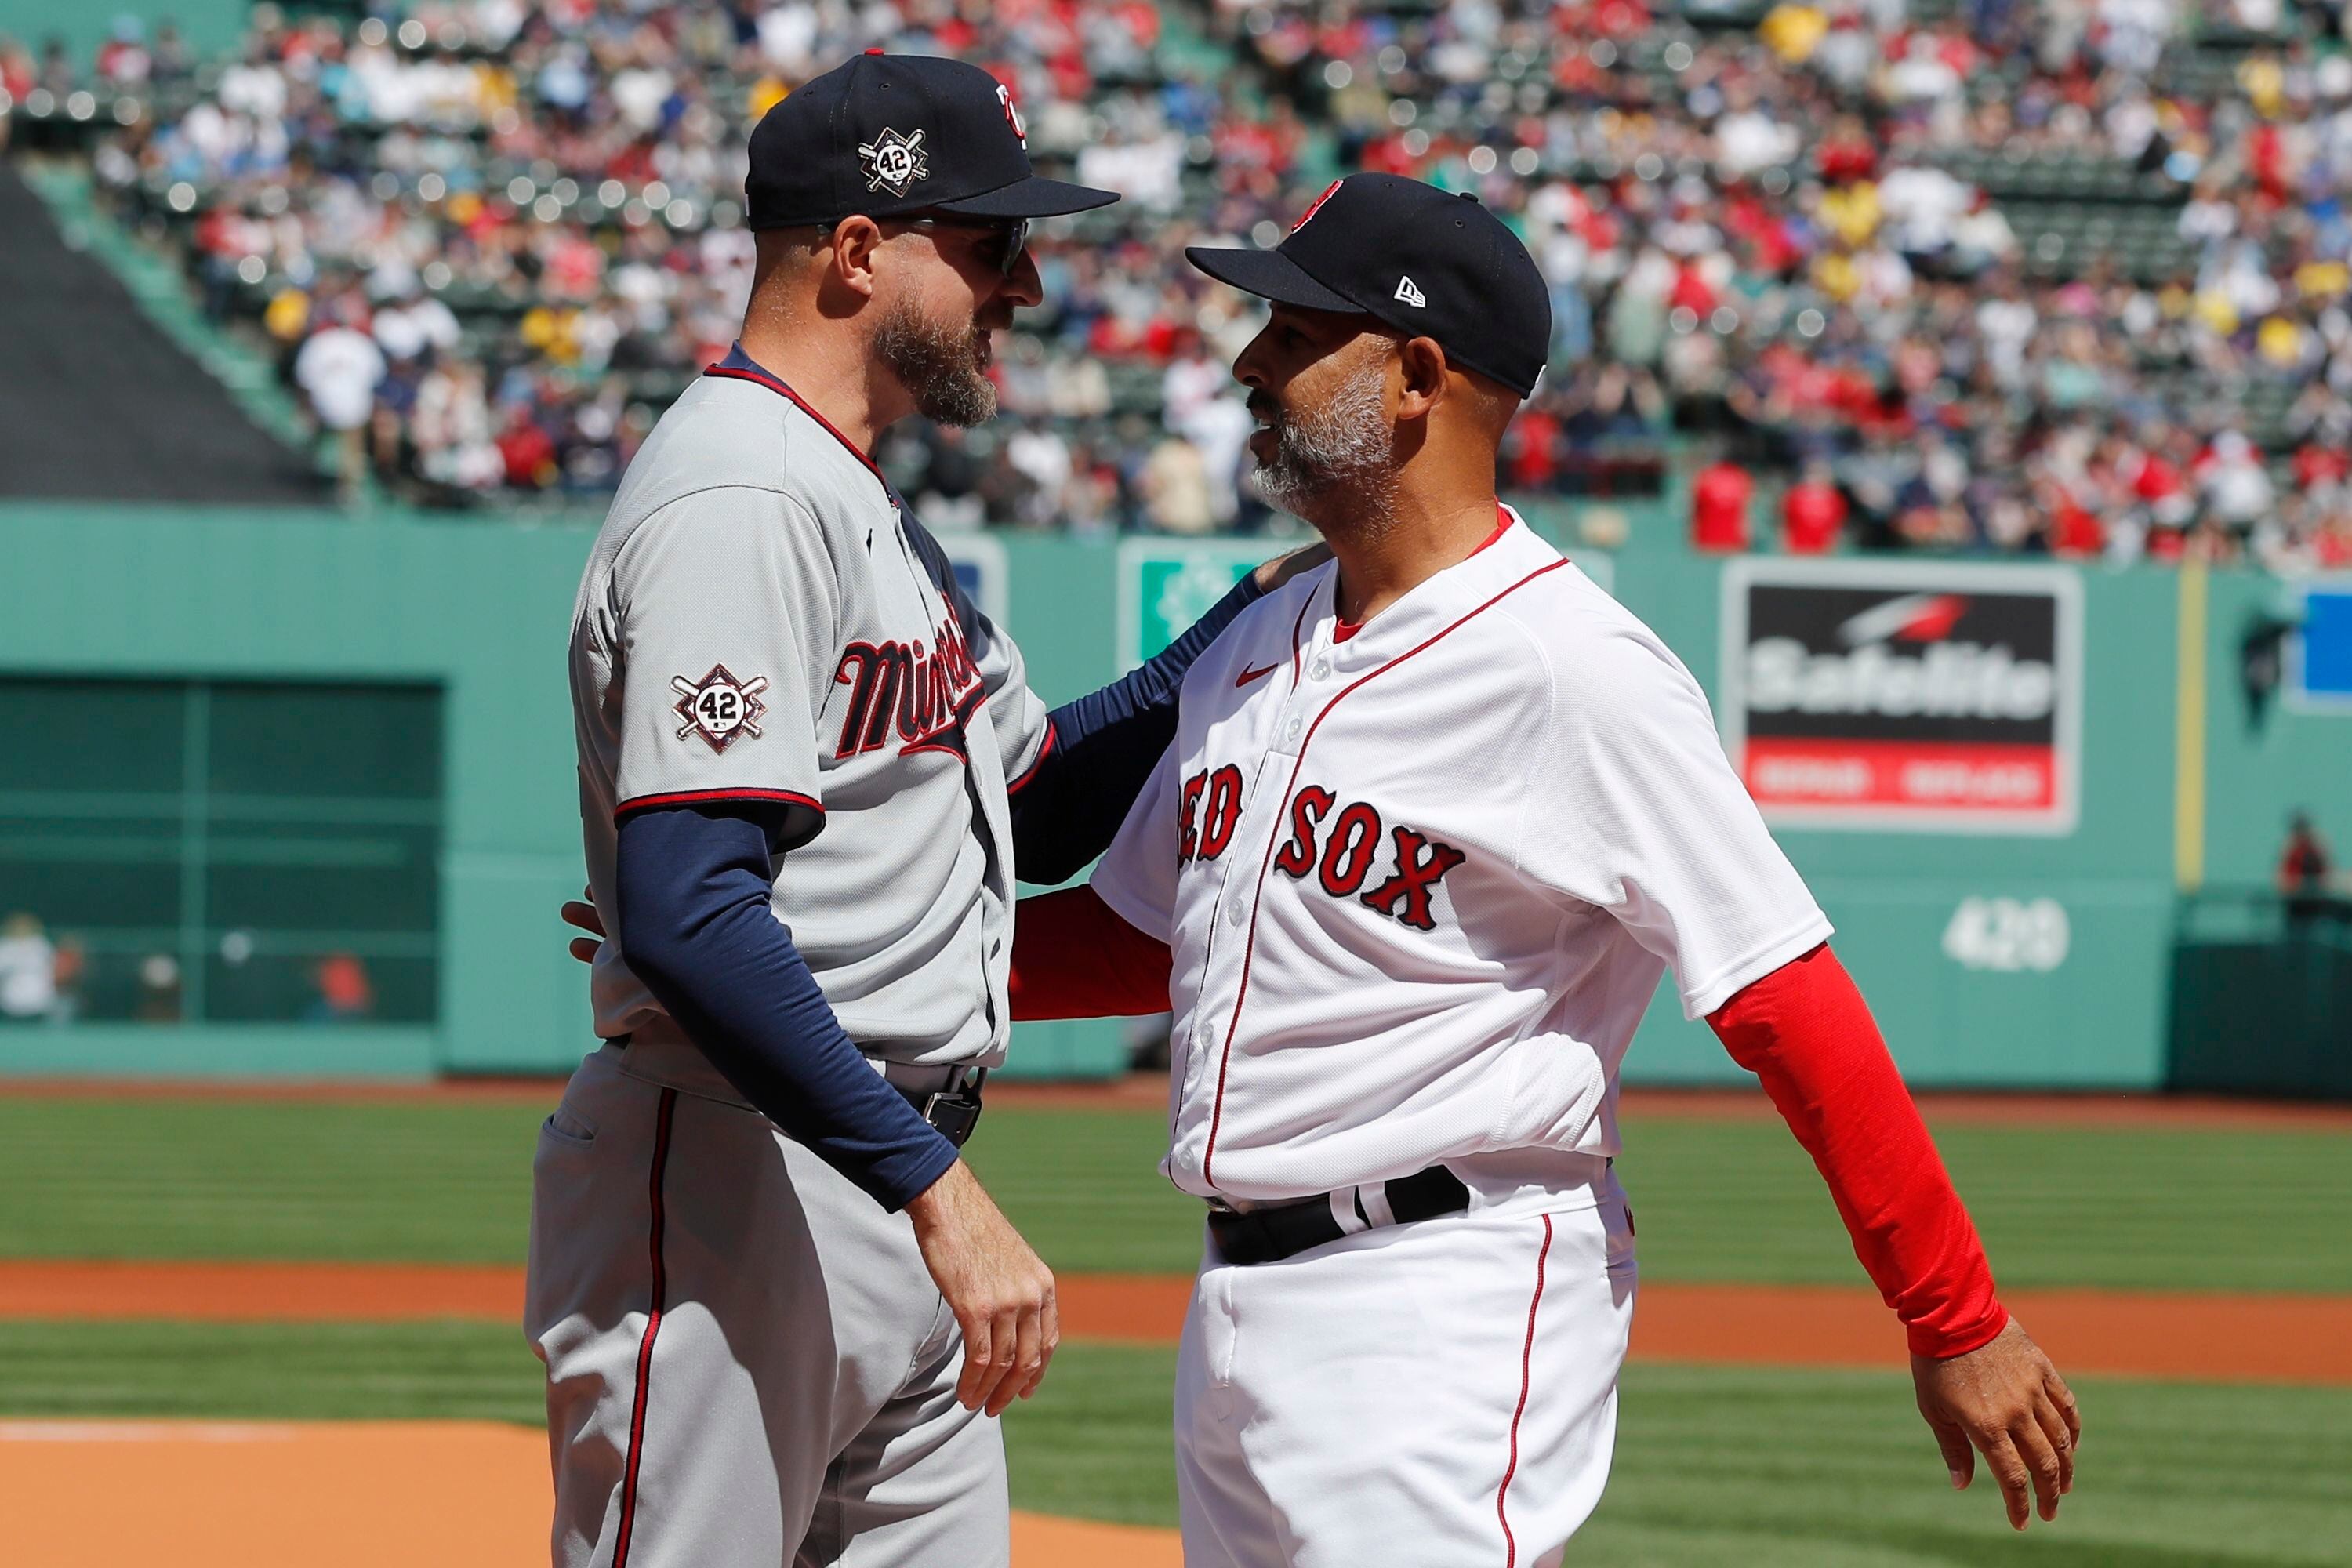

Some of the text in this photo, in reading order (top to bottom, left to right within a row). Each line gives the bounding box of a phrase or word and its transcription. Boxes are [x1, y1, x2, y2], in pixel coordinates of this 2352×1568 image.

[879, 149, 907, 173] 42
[699, 691, 737, 720] 42
[1749, 636, 2052, 720] Safelite
[1178, 763, 1466, 931] ED SOX
[1940, 894, 2071, 971] 420
